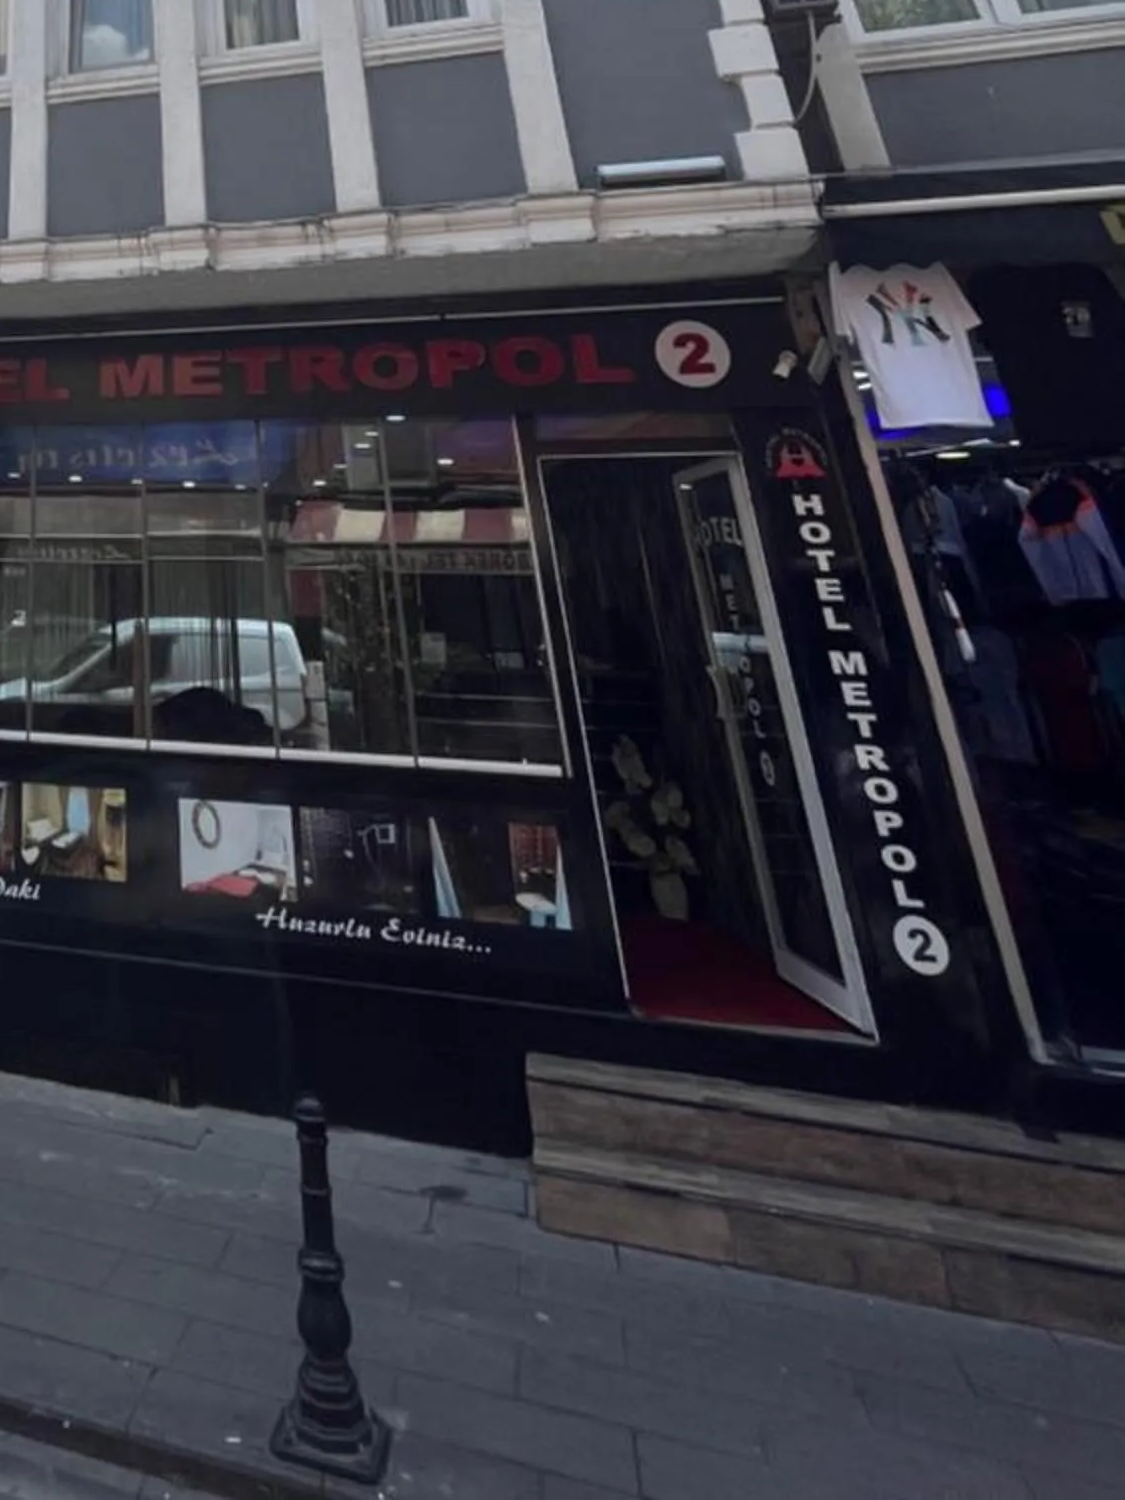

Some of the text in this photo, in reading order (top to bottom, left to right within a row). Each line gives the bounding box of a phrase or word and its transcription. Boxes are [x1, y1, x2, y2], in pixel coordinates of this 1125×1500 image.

[101, 335, 635, 399] METROPOL
[673, 333, 716, 376] 2
[720, 573, 766, 739] METOPOL
[794, 494, 852, 633] HOTEL
[828, 650, 925, 908] METROPOL
[256, 906, 372, 940] Huzurlu
